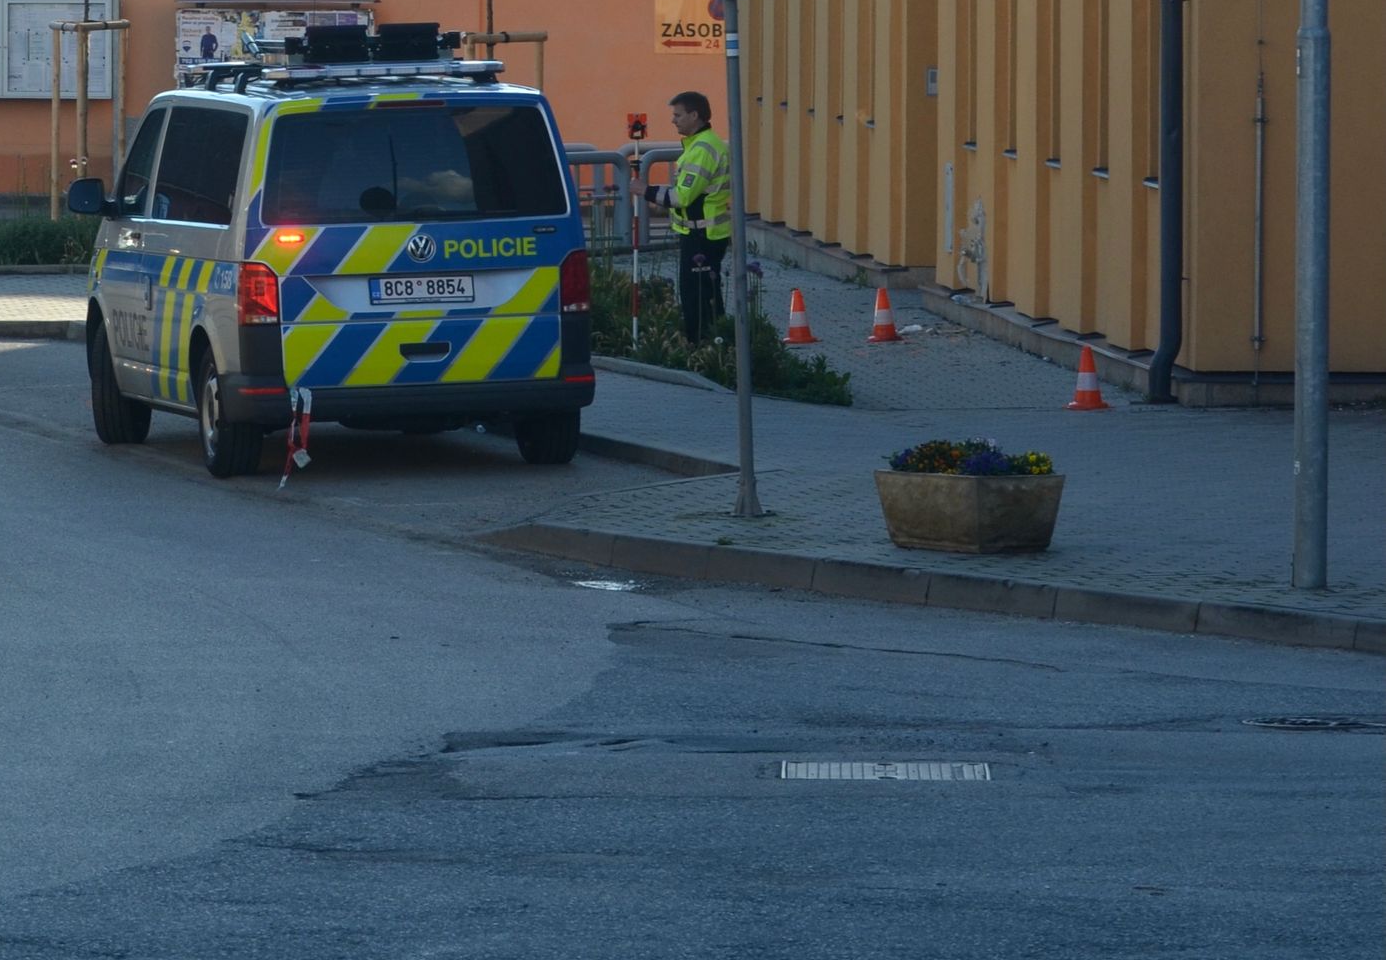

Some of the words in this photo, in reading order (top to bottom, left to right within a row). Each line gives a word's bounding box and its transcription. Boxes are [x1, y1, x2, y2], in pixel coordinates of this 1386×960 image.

[704, 39, 720, 49] 24
[443, 236, 537, 259] POLICIE
[384, 280, 414, 296] 8C8
[426, 278, 466, 295] 8854
[112, 308, 151, 352] POLICIE
